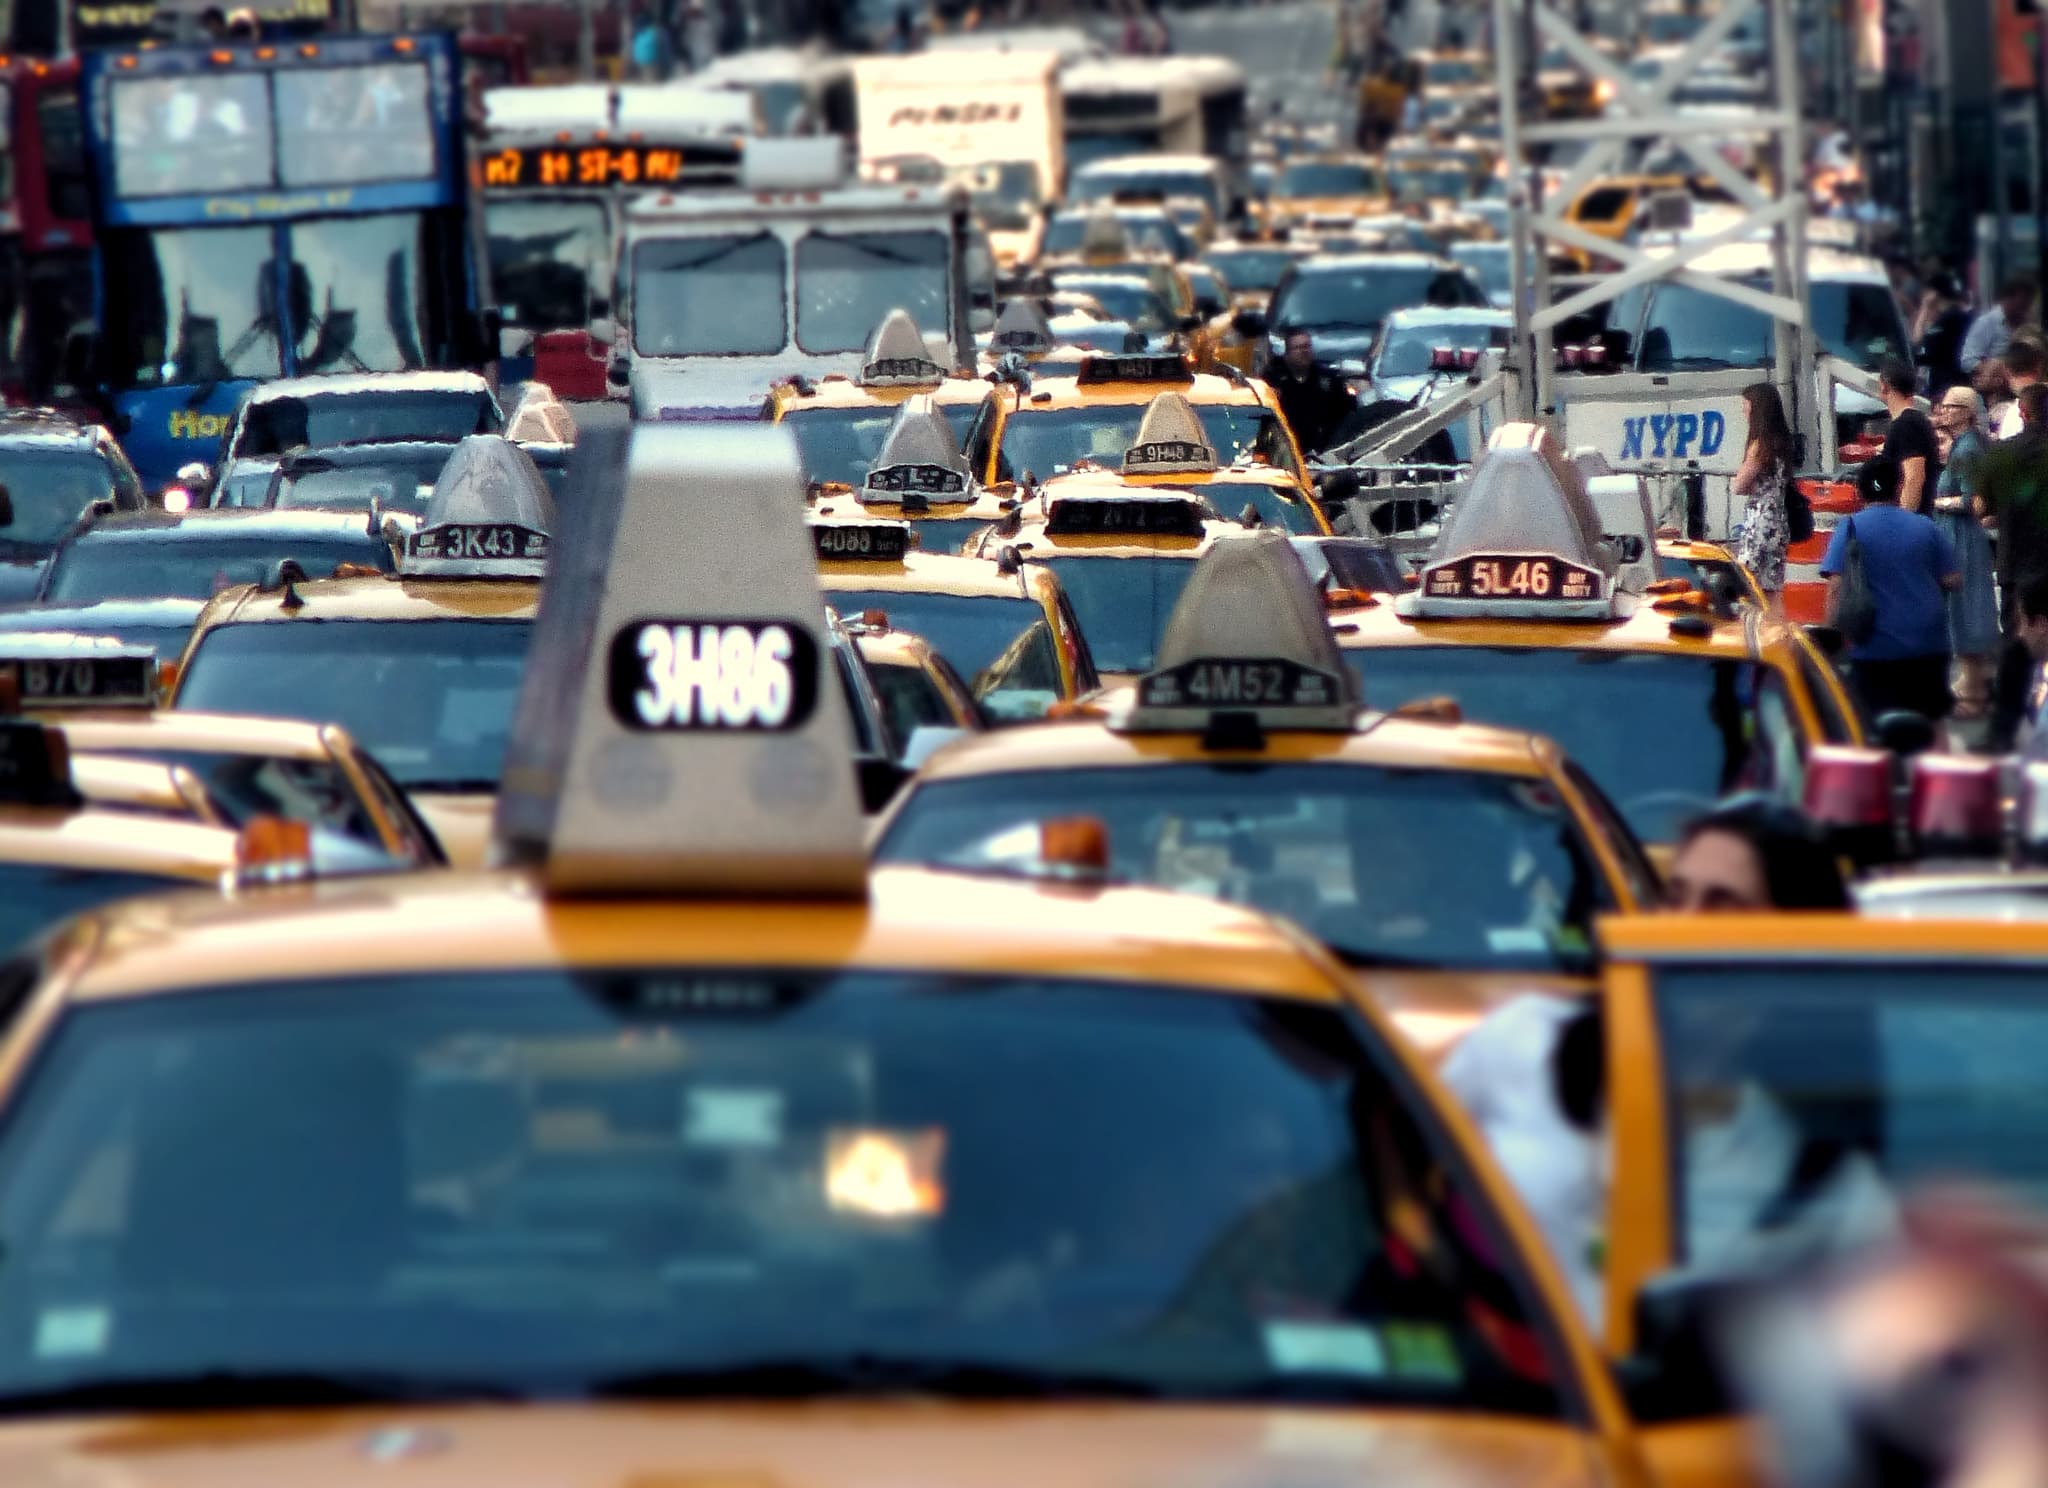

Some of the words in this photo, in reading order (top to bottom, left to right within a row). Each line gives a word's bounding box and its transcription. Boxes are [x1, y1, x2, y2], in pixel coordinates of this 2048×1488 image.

[1619, 410, 1725, 460] NYPD
[447, 526, 515, 557] 3K43
[1471, 561, 1550, 595] 5L46
[635, 623, 793, 727] 3H86
[1188, 663, 1284, 700] 4M52
